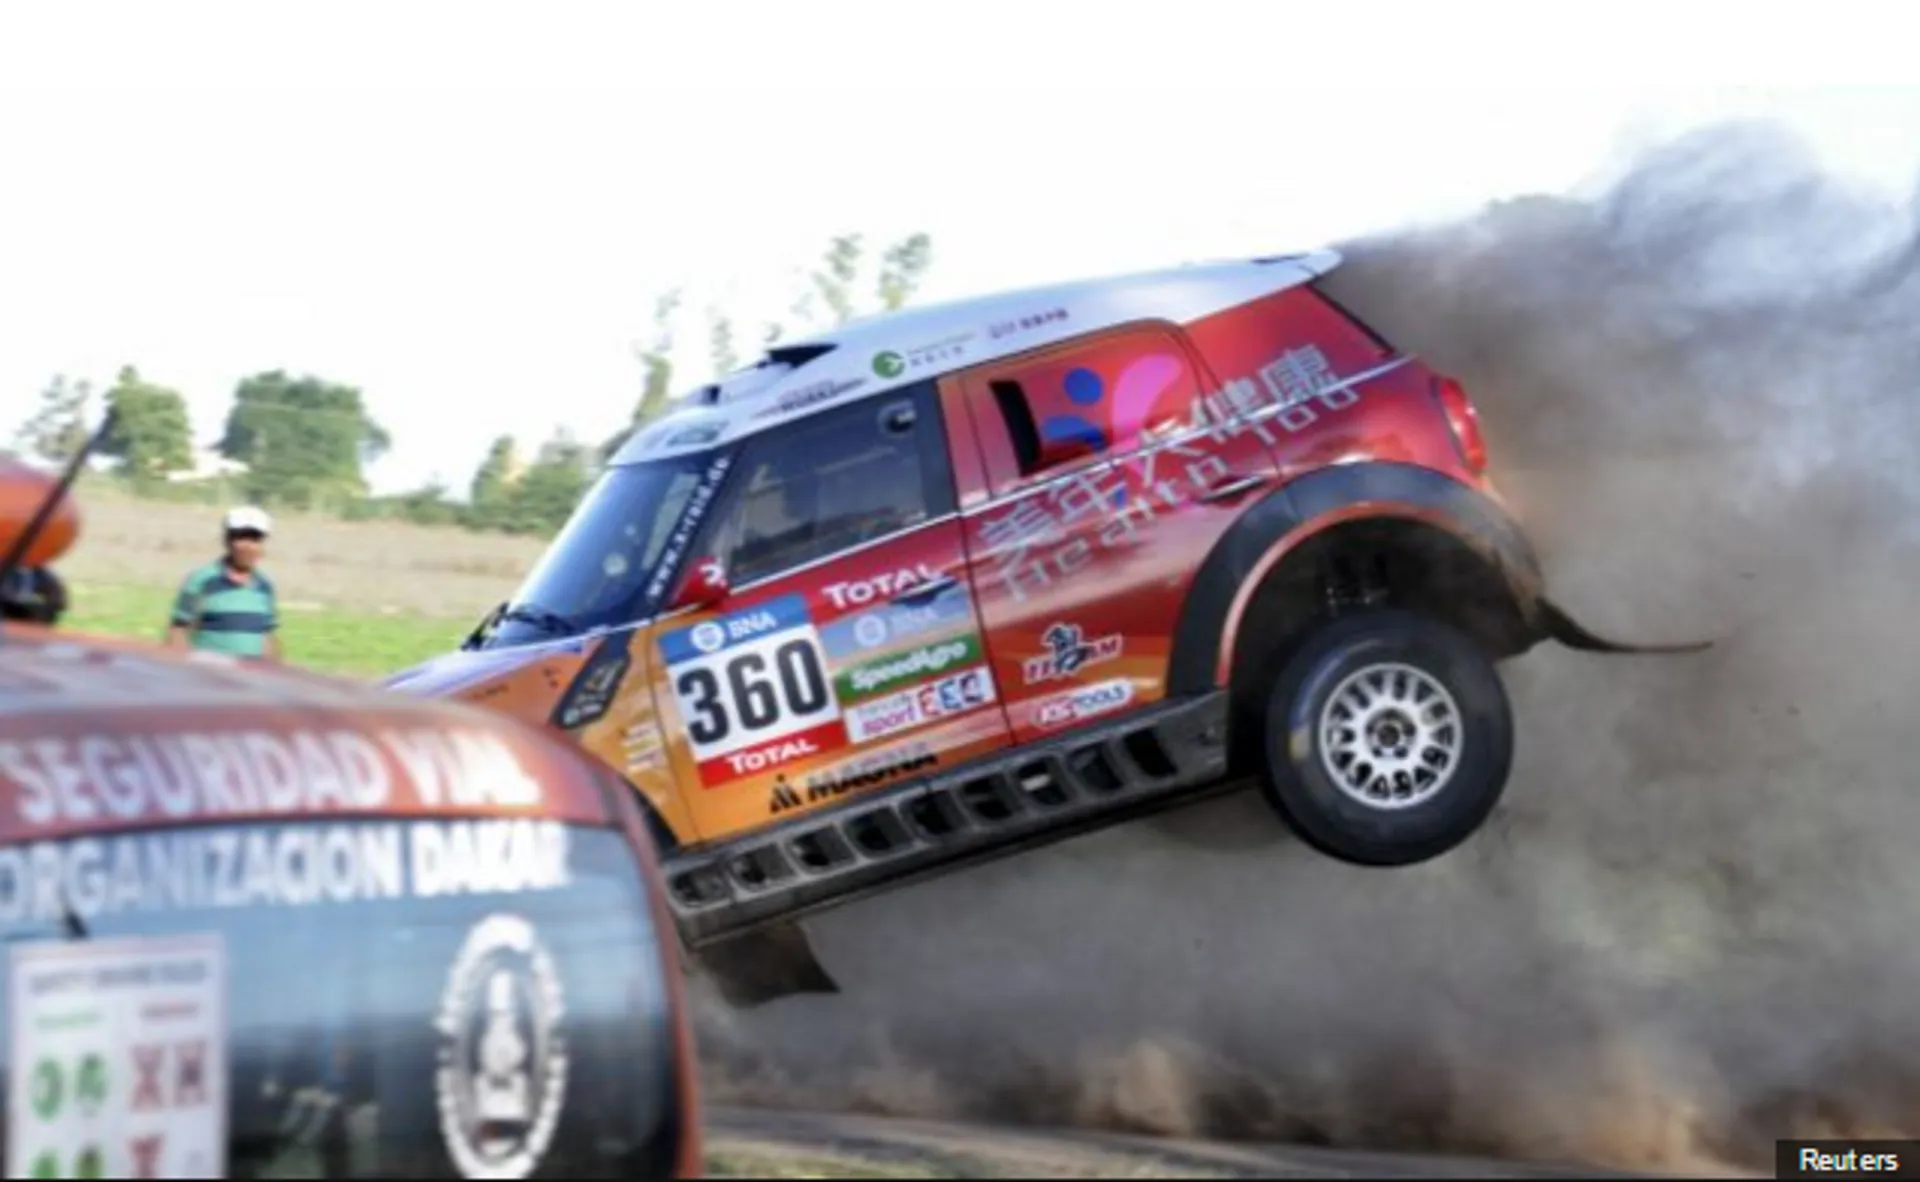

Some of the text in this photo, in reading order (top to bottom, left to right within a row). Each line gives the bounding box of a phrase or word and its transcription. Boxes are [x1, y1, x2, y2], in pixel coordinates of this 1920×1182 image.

[820, 563, 946, 609] TOTAL
[726, 611, 778, 641] BNA
[677, 638, 831, 745] 360
[2, 731, 390, 823] SEGURIDAD
[391, 728, 543, 806] VIAL
[726, 737, 820, 775] TOTAL
[411, 818, 570, 896] DAKAR
